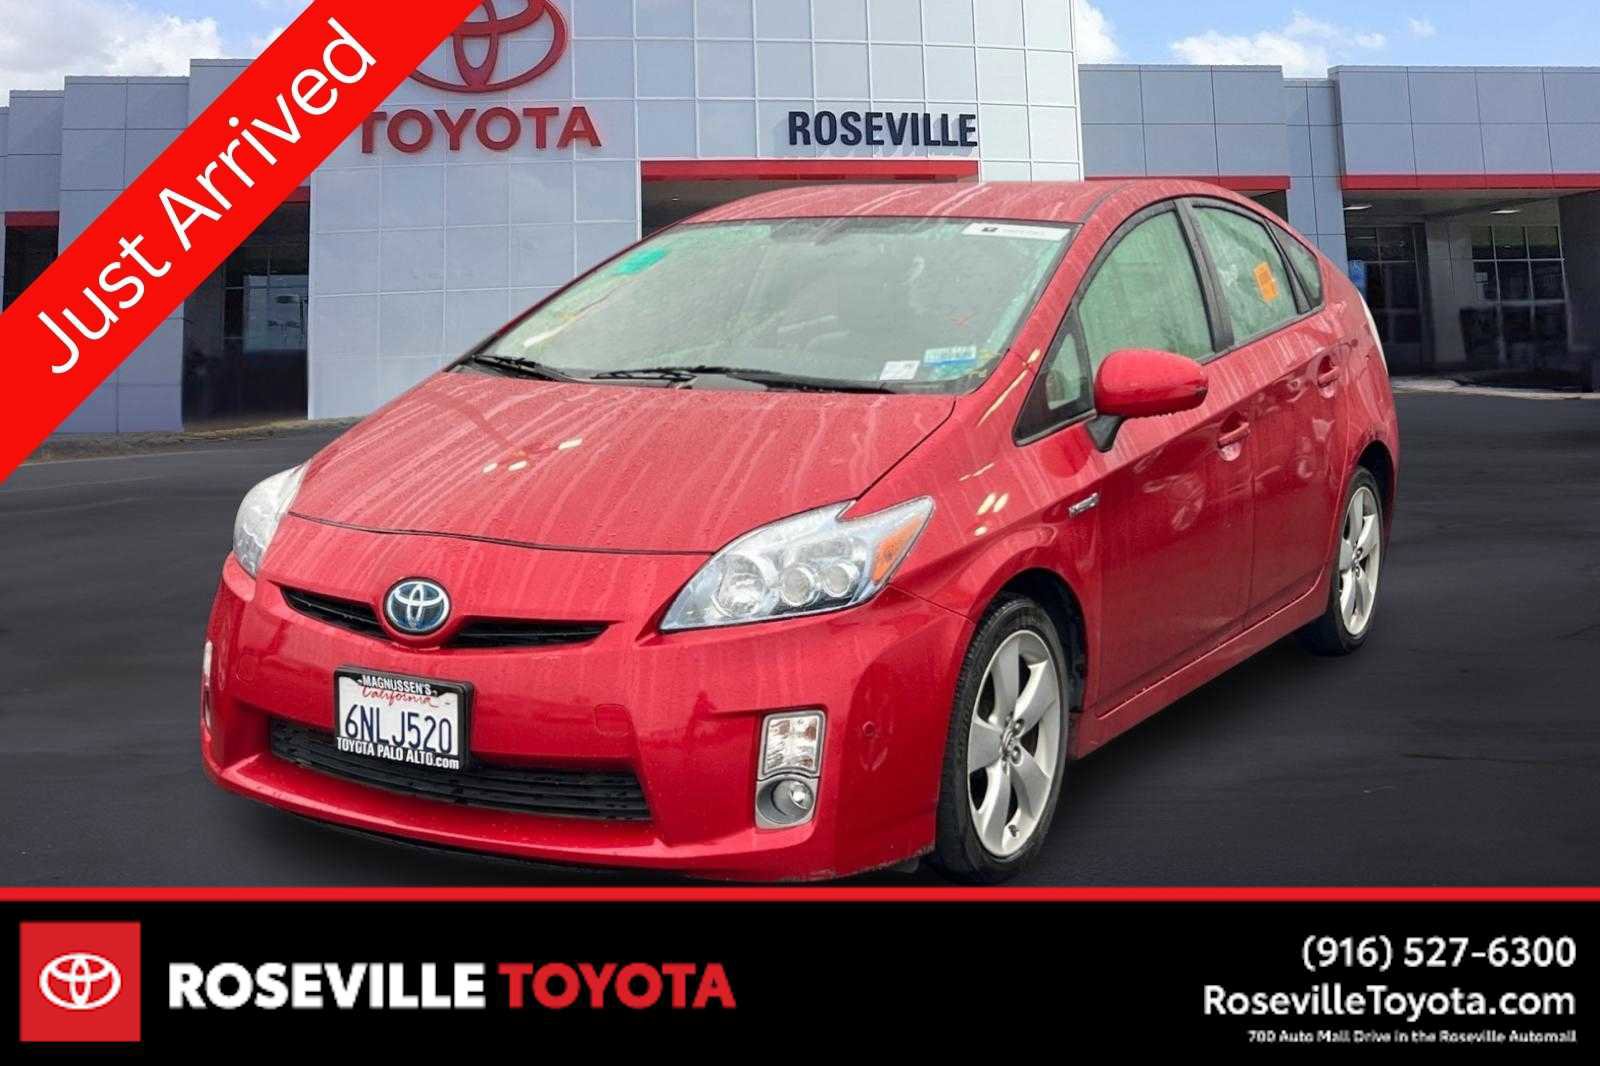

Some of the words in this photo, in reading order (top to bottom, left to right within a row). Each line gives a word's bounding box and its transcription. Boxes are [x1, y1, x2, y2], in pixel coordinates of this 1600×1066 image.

[361, 106, 602, 154] TOYOTA
[788, 110, 978, 147] ROSEVILLE
[361, 674, 432, 695] MAGNUSSEN'S
[344, 704, 453, 754] 6NLJ520
[336, 736, 375, 757] TOYOTA
[376, 743, 403, 761] PALO
[405, 750, 460, 769] ALTO.com
